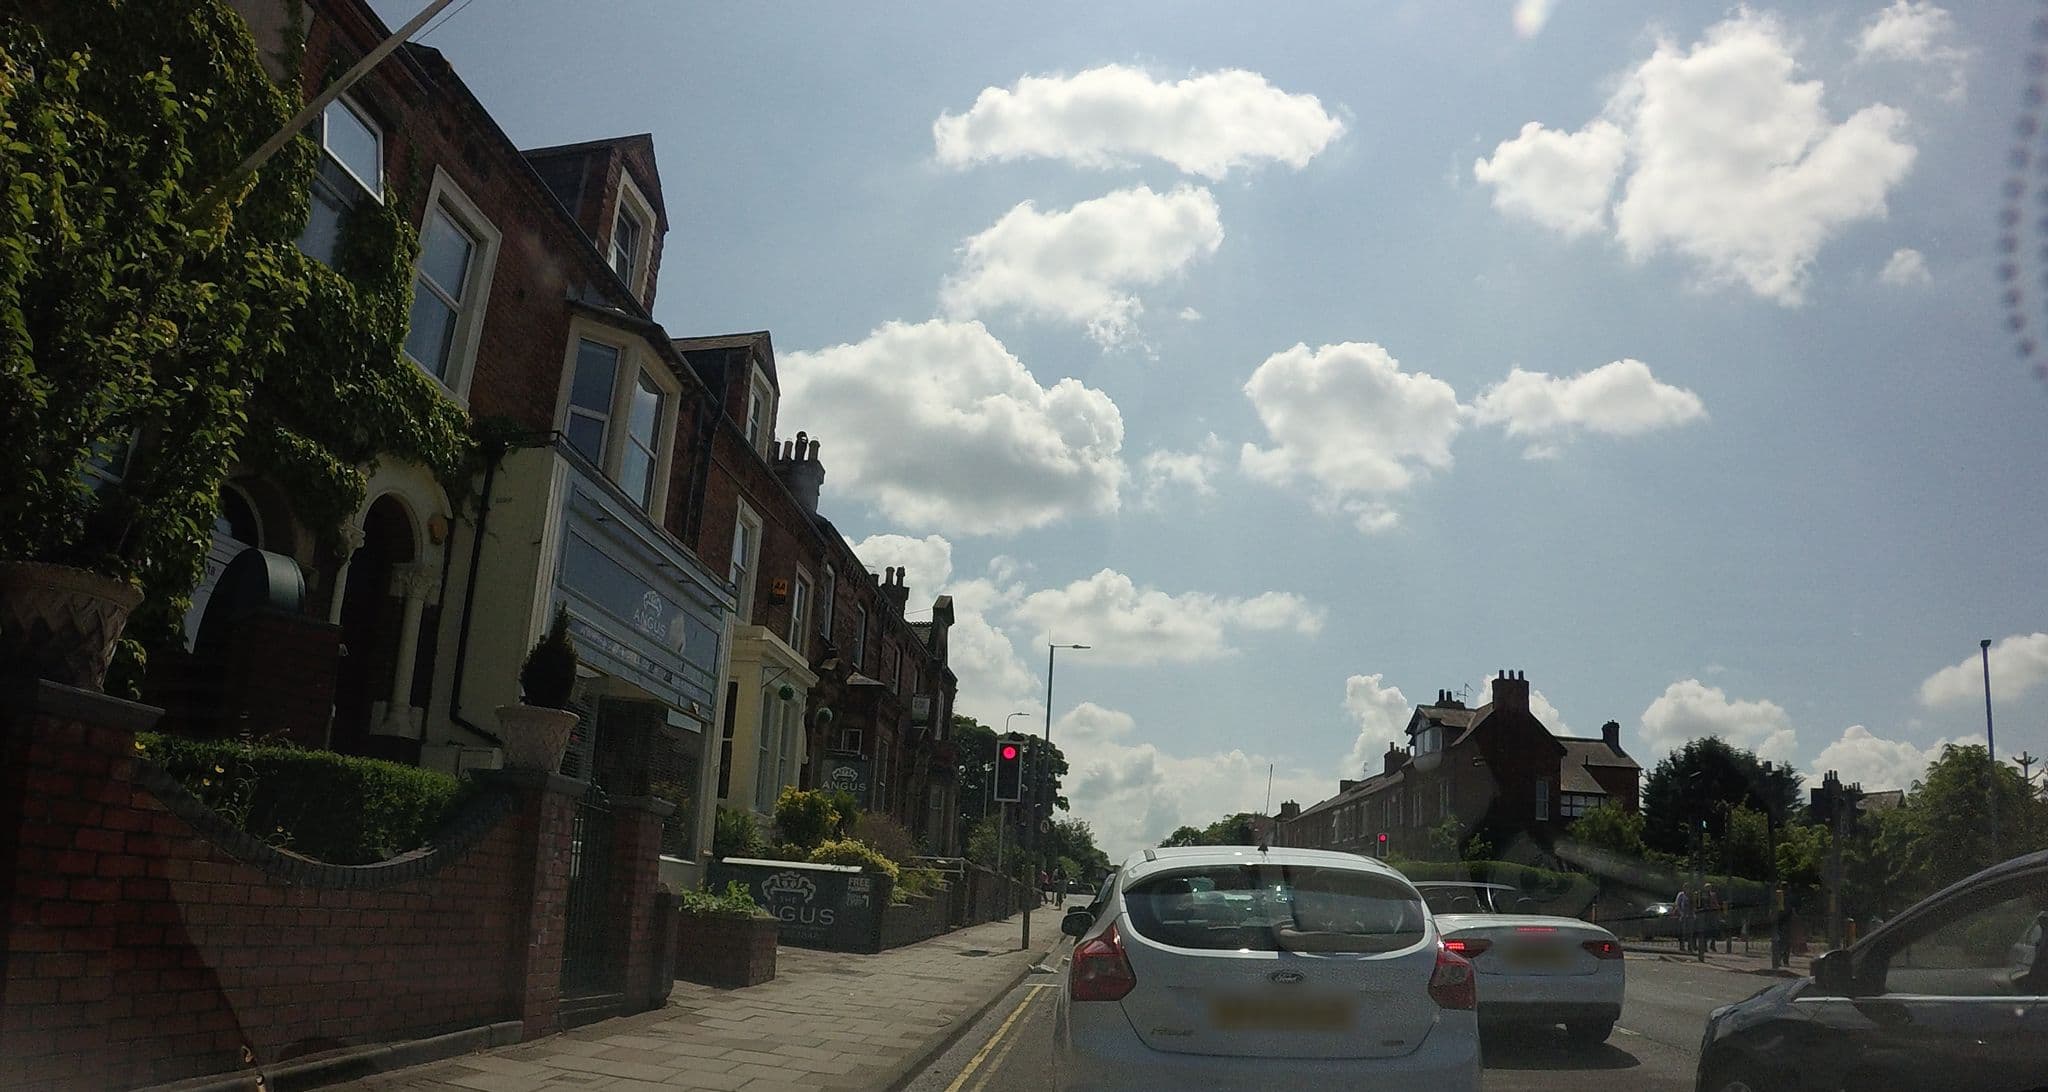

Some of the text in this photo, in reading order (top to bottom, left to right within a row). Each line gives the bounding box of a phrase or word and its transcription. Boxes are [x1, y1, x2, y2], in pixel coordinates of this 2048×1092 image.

[633, 608, 666, 637] ANGUS
[822, 780, 866, 792] ANGUS
[848, 877, 871, 887] FREE
[768, 904, 834, 926] GUS
